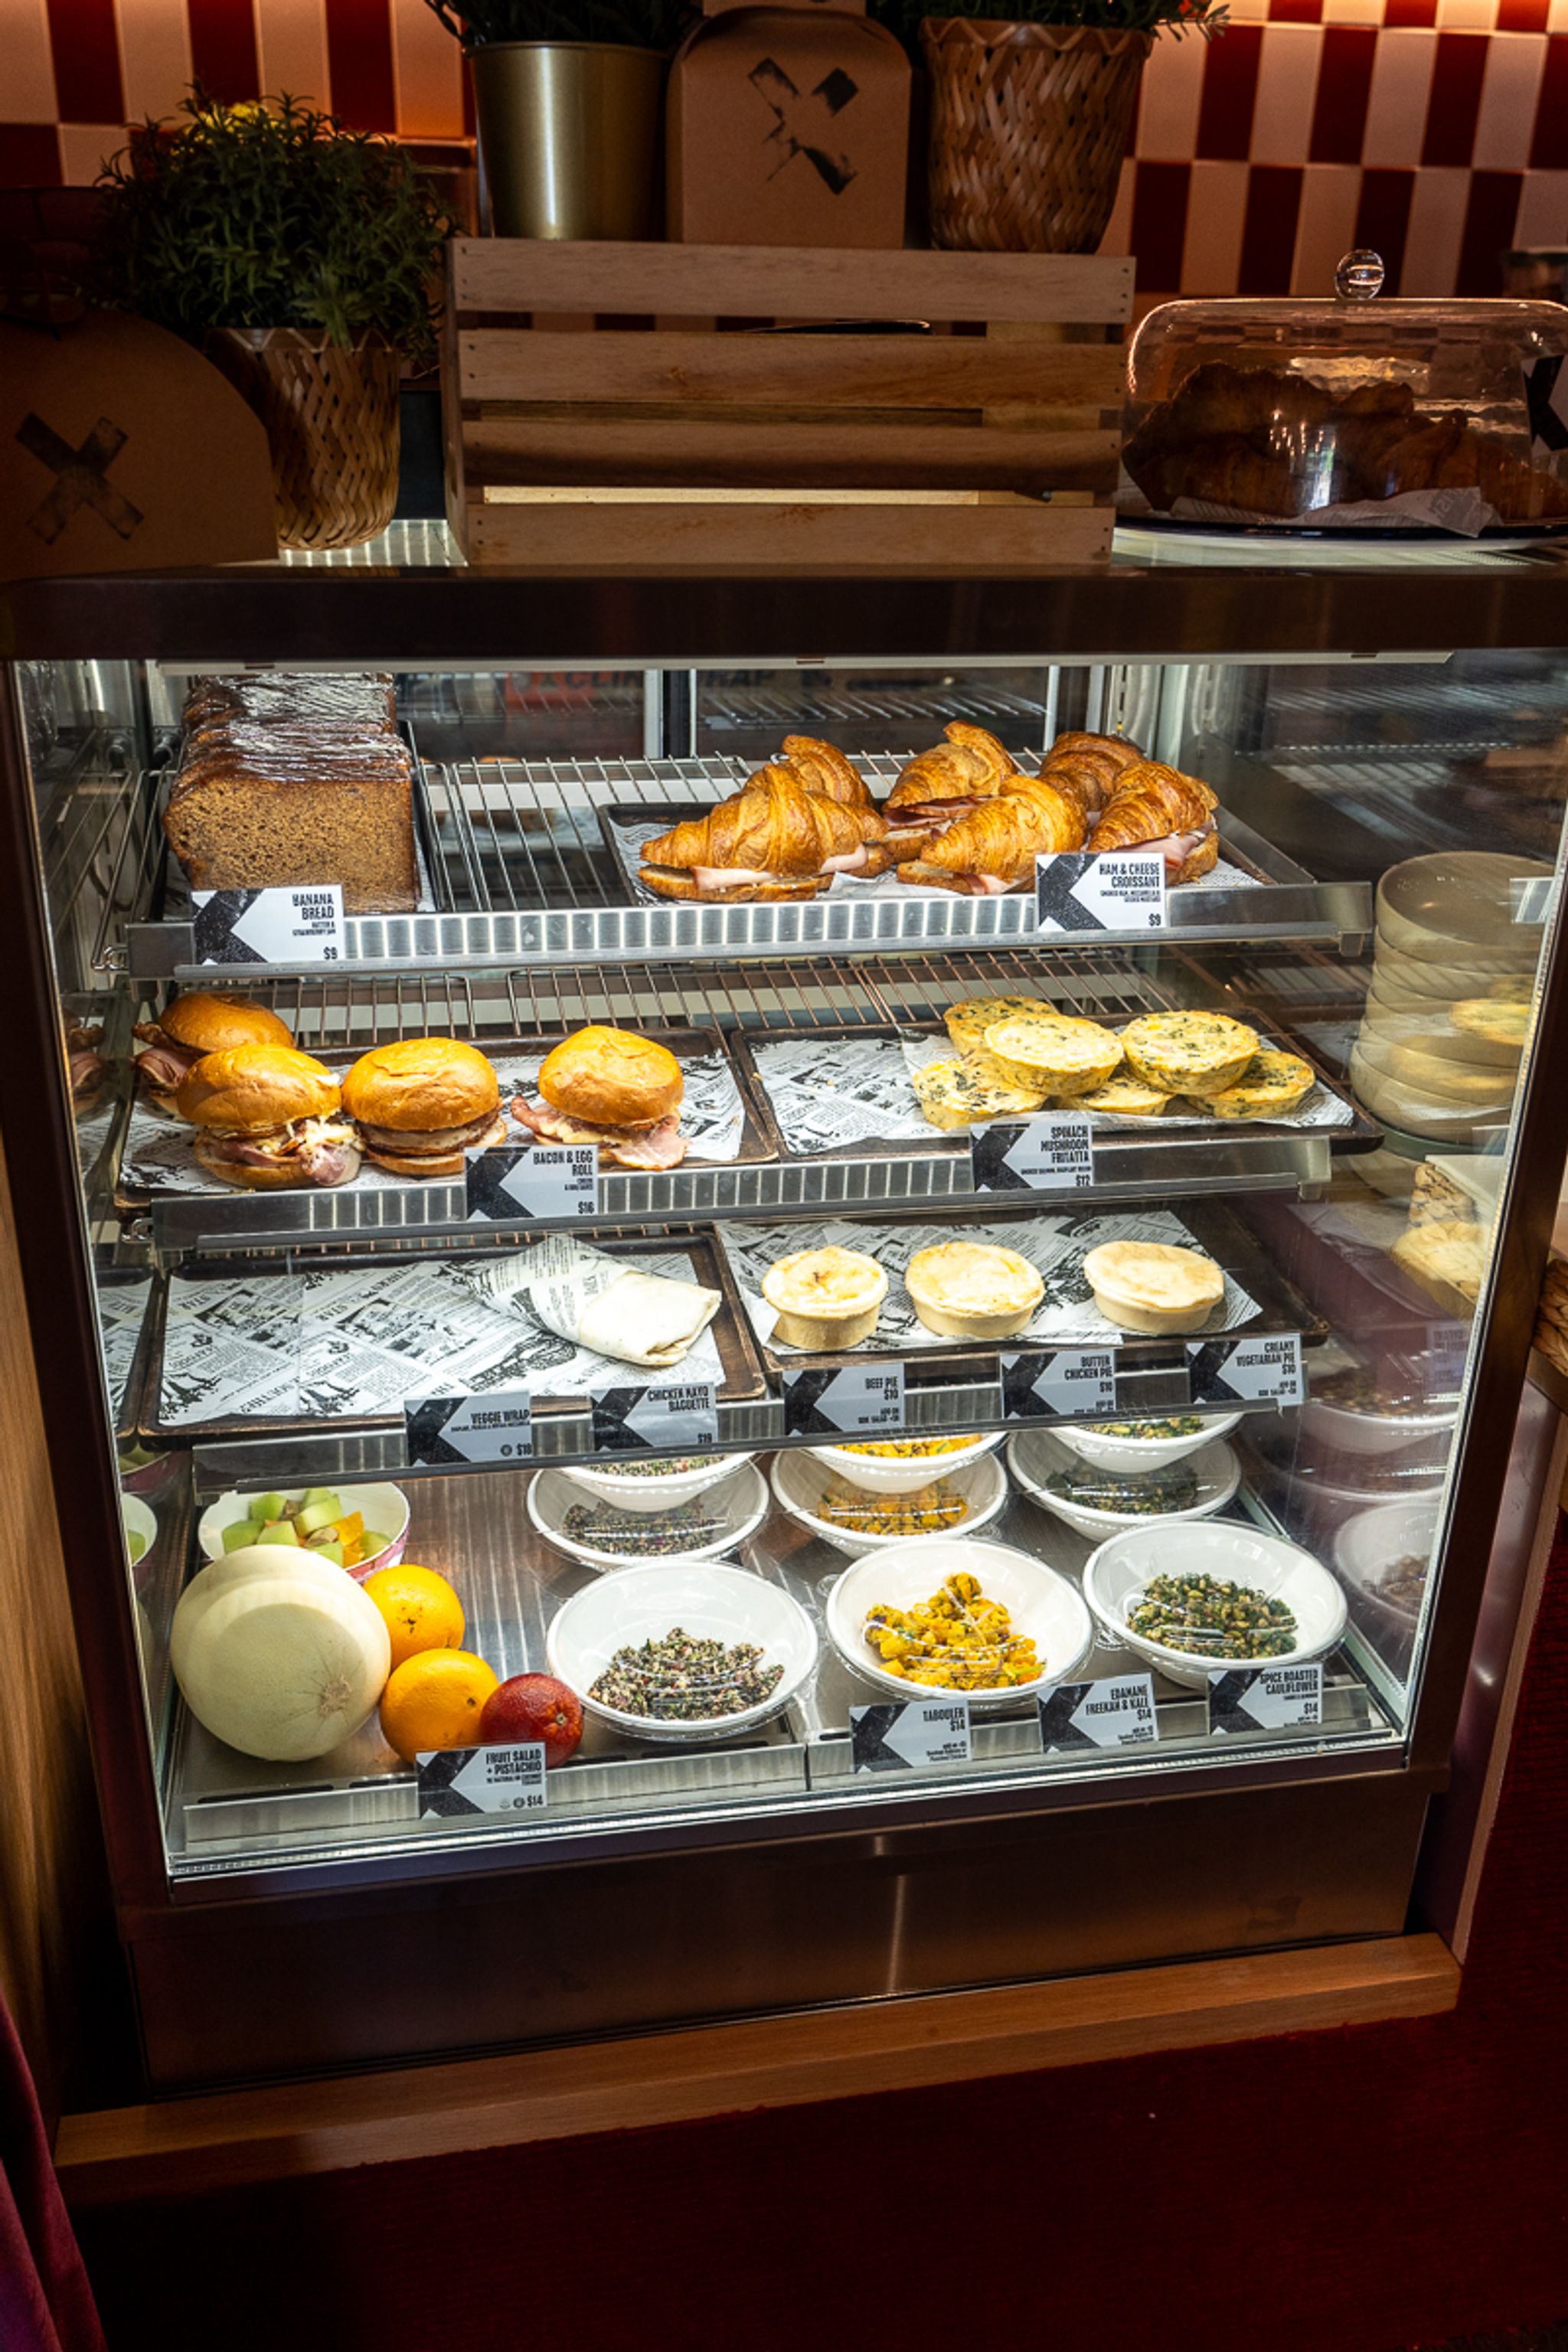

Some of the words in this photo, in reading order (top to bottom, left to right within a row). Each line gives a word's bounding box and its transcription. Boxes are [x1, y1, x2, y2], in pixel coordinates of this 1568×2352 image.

[1099, 863, 1118, 875] HAM
[1119, 863, 1127, 874] &
[1129, 862, 1159, 874] CHEESE
[1111, 877, 1160, 888] CROISSANT
[292, 893, 334, 906] BANANA
[302, 906, 334, 920] BREAD
[1148, 913, 1161, 926] $9
[323, 946, 338, 960] $9
[1051, 1125, 1089, 1139] SPINACH
[1040, 1138, 1089, 1152] MUSHROOM
[534, 1151, 565, 1165] BACON
[567, 1151, 573, 1163] &
[577, 1151, 593, 1163] EGG
[572, 1164, 593, 1176] ROLL
[1265, 1341, 1294, 1353] CREAMY
[1081, 1355, 1110, 1367] BUTTER
[1236, 1354, 1282, 1367] VEGETARIAN
[1284, 1353, 1295, 1363] PIE
[1065, 1367, 1098, 1380] CHICKEN
[1100, 1367, 1112, 1378] PIE
[865, 1377, 883, 1390] BEEF
[886, 1377, 898, 1388] PIE
[648, 1387, 684, 1402] CHICKEN
[668, 1397, 709, 1412] BAGUETTE
[471, 1411, 501, 1424] VEGGIE
[502, 1409, 530, 1422] WRAP
[1260, 1672, 1282, 1685] SPICE
[1284, 1669, 1318, 1682] ROASTED
[1111, 1684, 1148, 1699] EDAMAME
[1266, 1681, 1318, 1695] CAULIFLOWER
[1122, 1699, 1129, 1710] &
[1130, 1697, 1148, 1709] KALE
[486, 1752, 511, 1765] FRUIT
[512, 1749, 541, 1762] SALAD
[495, 1761, 541, 1775] PISTACHIO
[527, 1795, 544, 1808] $14
